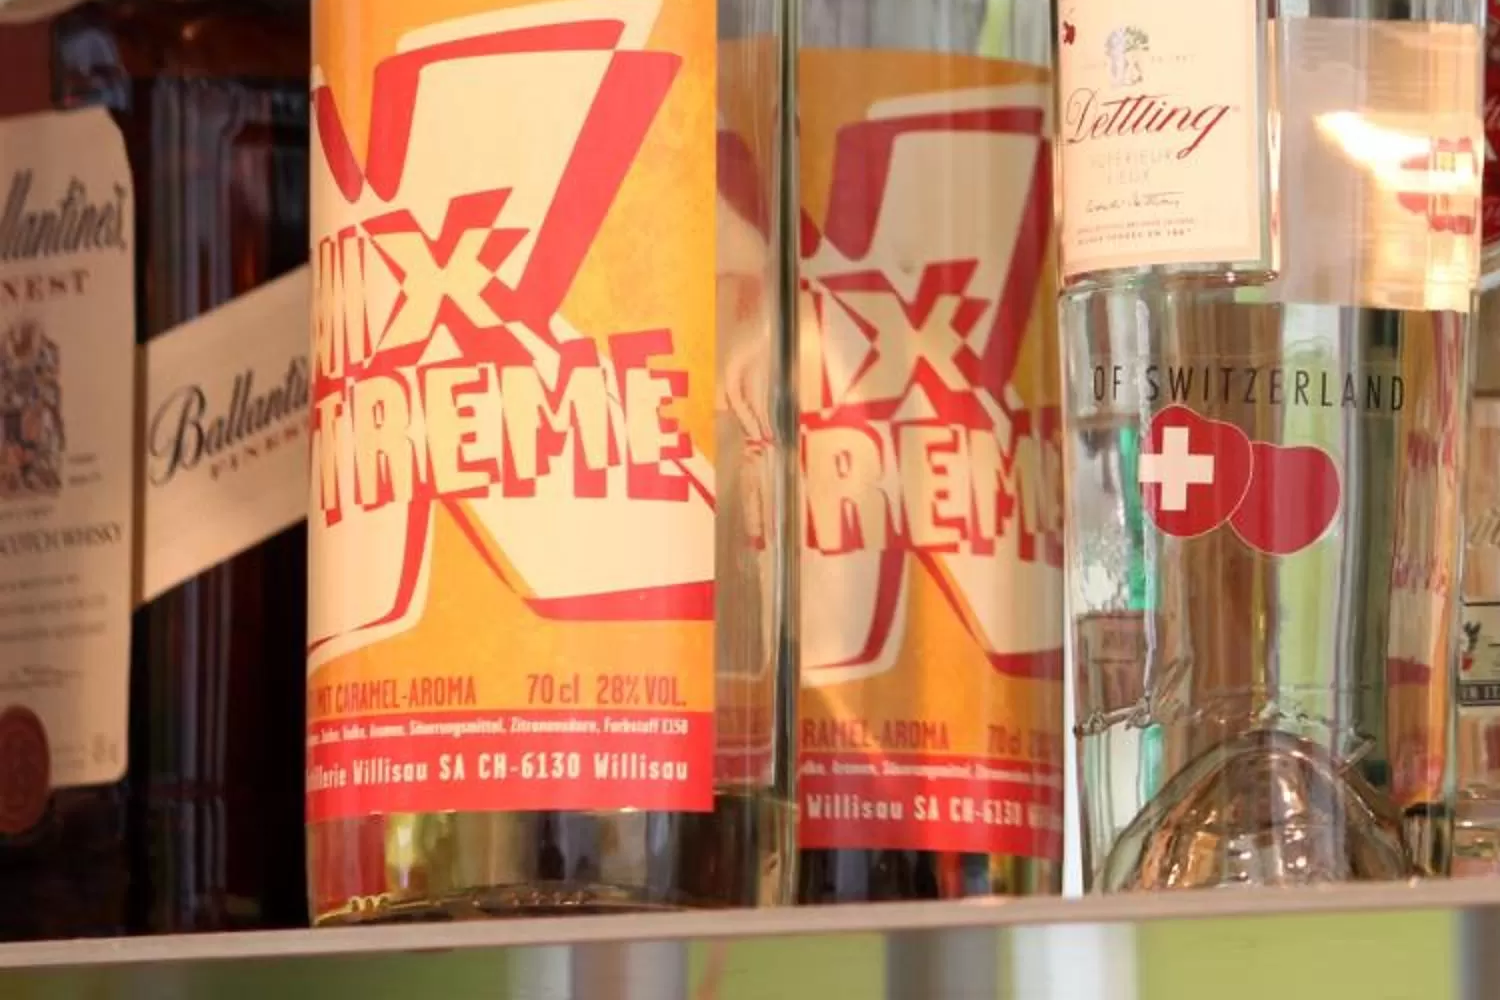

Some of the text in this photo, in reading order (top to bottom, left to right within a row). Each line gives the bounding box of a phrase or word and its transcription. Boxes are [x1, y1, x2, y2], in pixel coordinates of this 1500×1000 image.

[1063, 86, 1231, 160] Dettling
[1093, 365, 1406, 412] OF SWITZERLAND
[353, 755, 429, 787] Willisau
[438, 752, 465, 782] SA
[478, 751, 581, 781] CH-6130
[593, 751, 688, 781] Willisau
[806, 793, 904, 821] Willisau
[913, 796, 941, 821] SA
